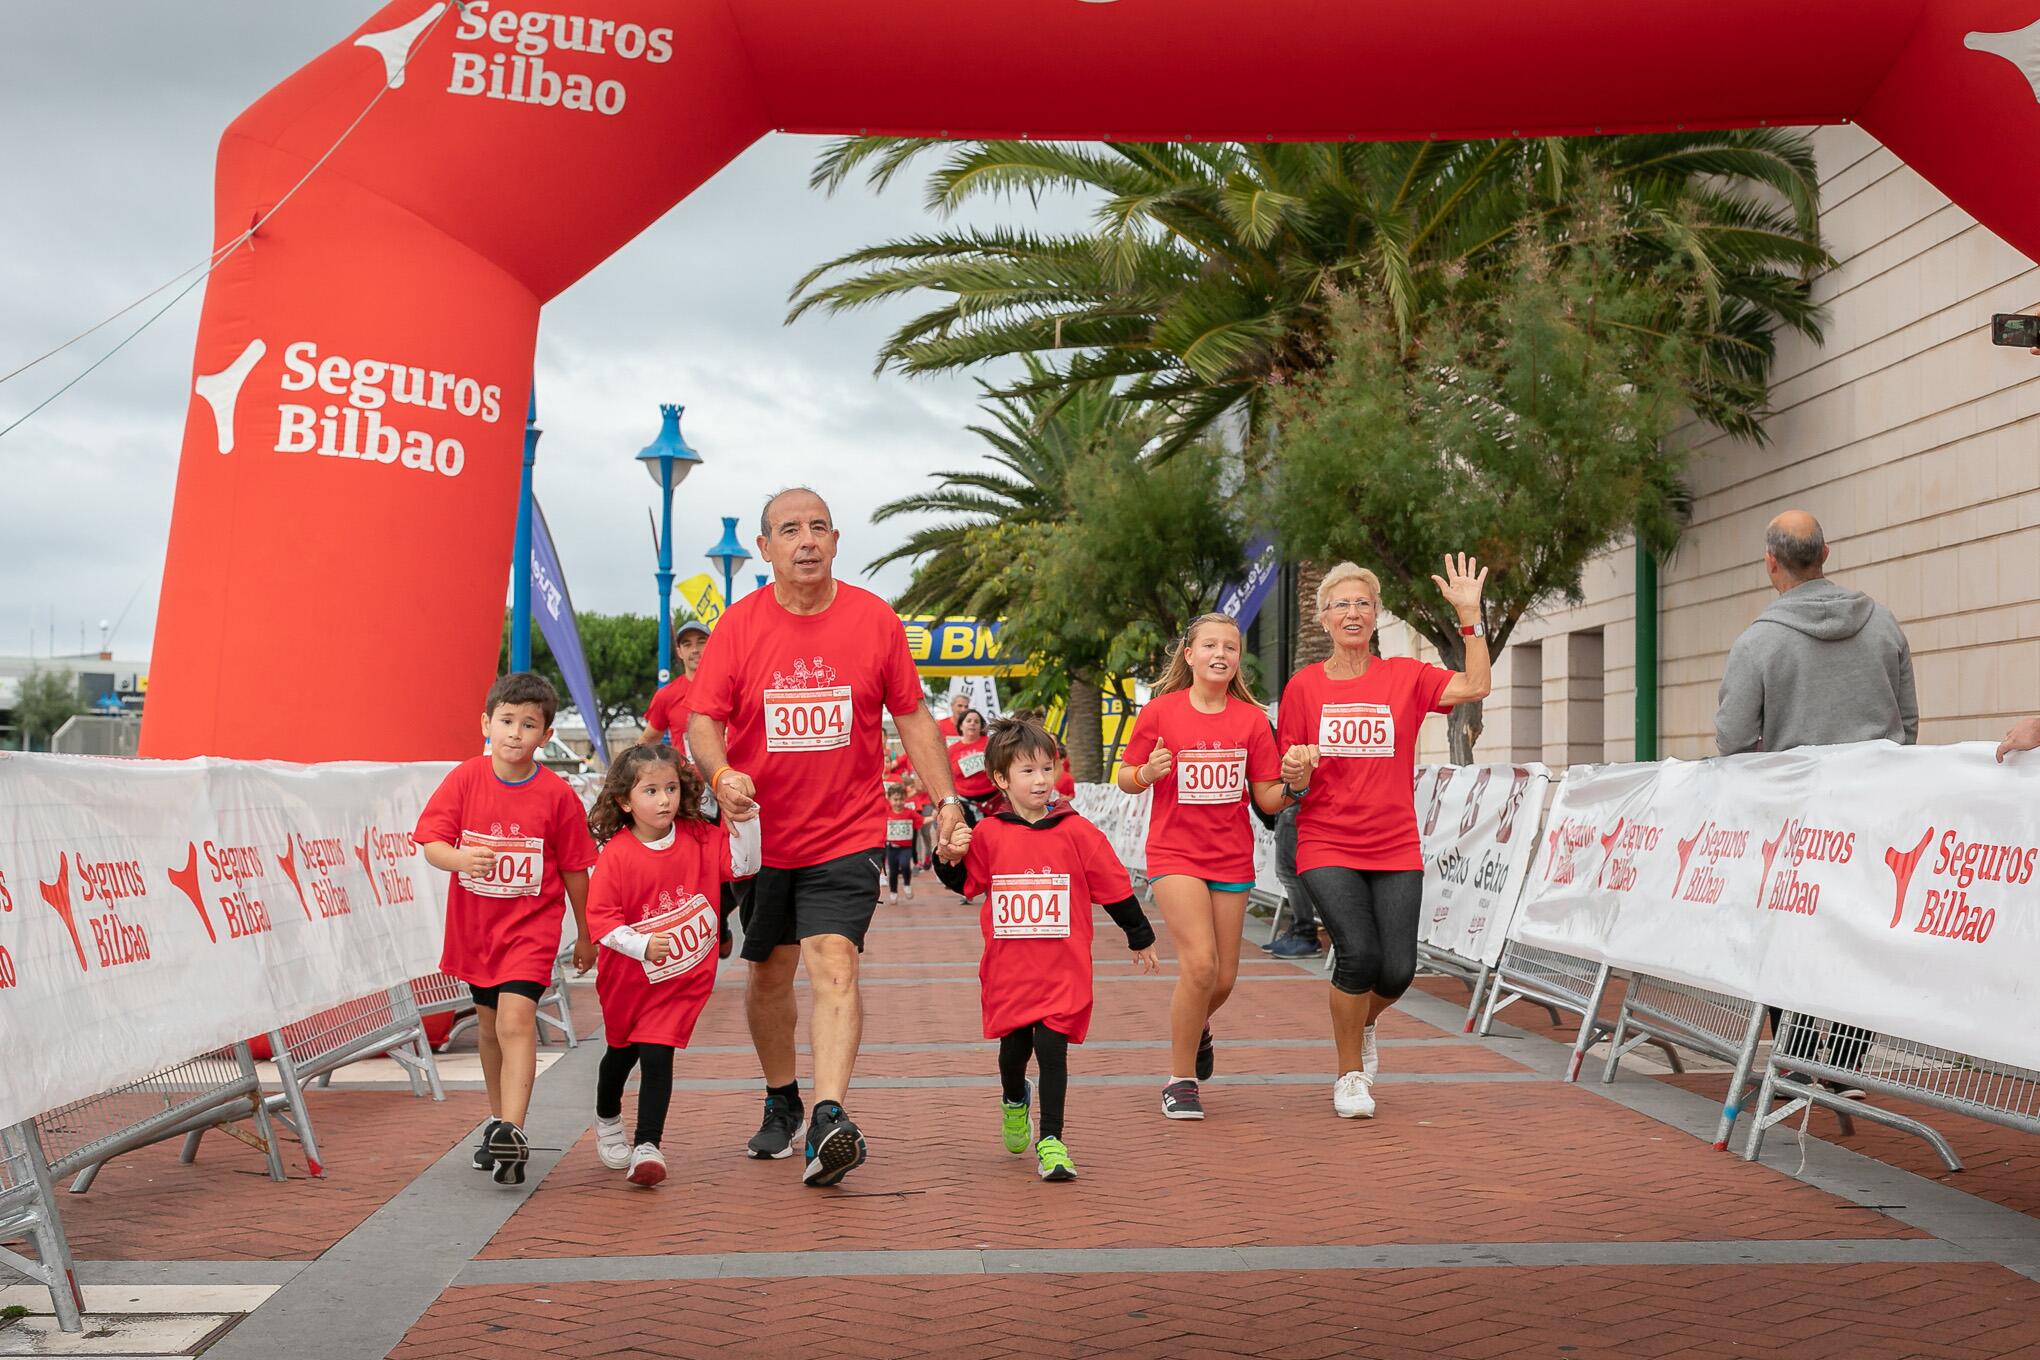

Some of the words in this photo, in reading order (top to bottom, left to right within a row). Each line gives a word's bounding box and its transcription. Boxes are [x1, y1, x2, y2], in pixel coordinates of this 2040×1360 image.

[455, 1, 673, 63] Seguros
[447, 52, 626, 115] Bilbao
[280, 342, 501, 423] Seguros
[274, 403, 465, 477] Bilbao
[775, 705, 844, 736] 3004
[1327, 720, 1387, 745] 3005
[1186, 764, 1239, 789] 3005
[1700, 822, 1750, 865] Seguros
[1933, 830, 2038, 888] Seguros
[76, 852, 146, 910] Seguros
[1683, 867, 1726, 905] Bilbao
[1768, 870, 1820, 916] Bilbao
[998, 894, 1061, 924] 3004
[1913, 889, 1995, 943] Bilbao
[89, 914, 151, 967] Bilbao
[652, 914, 712, 967] 004
